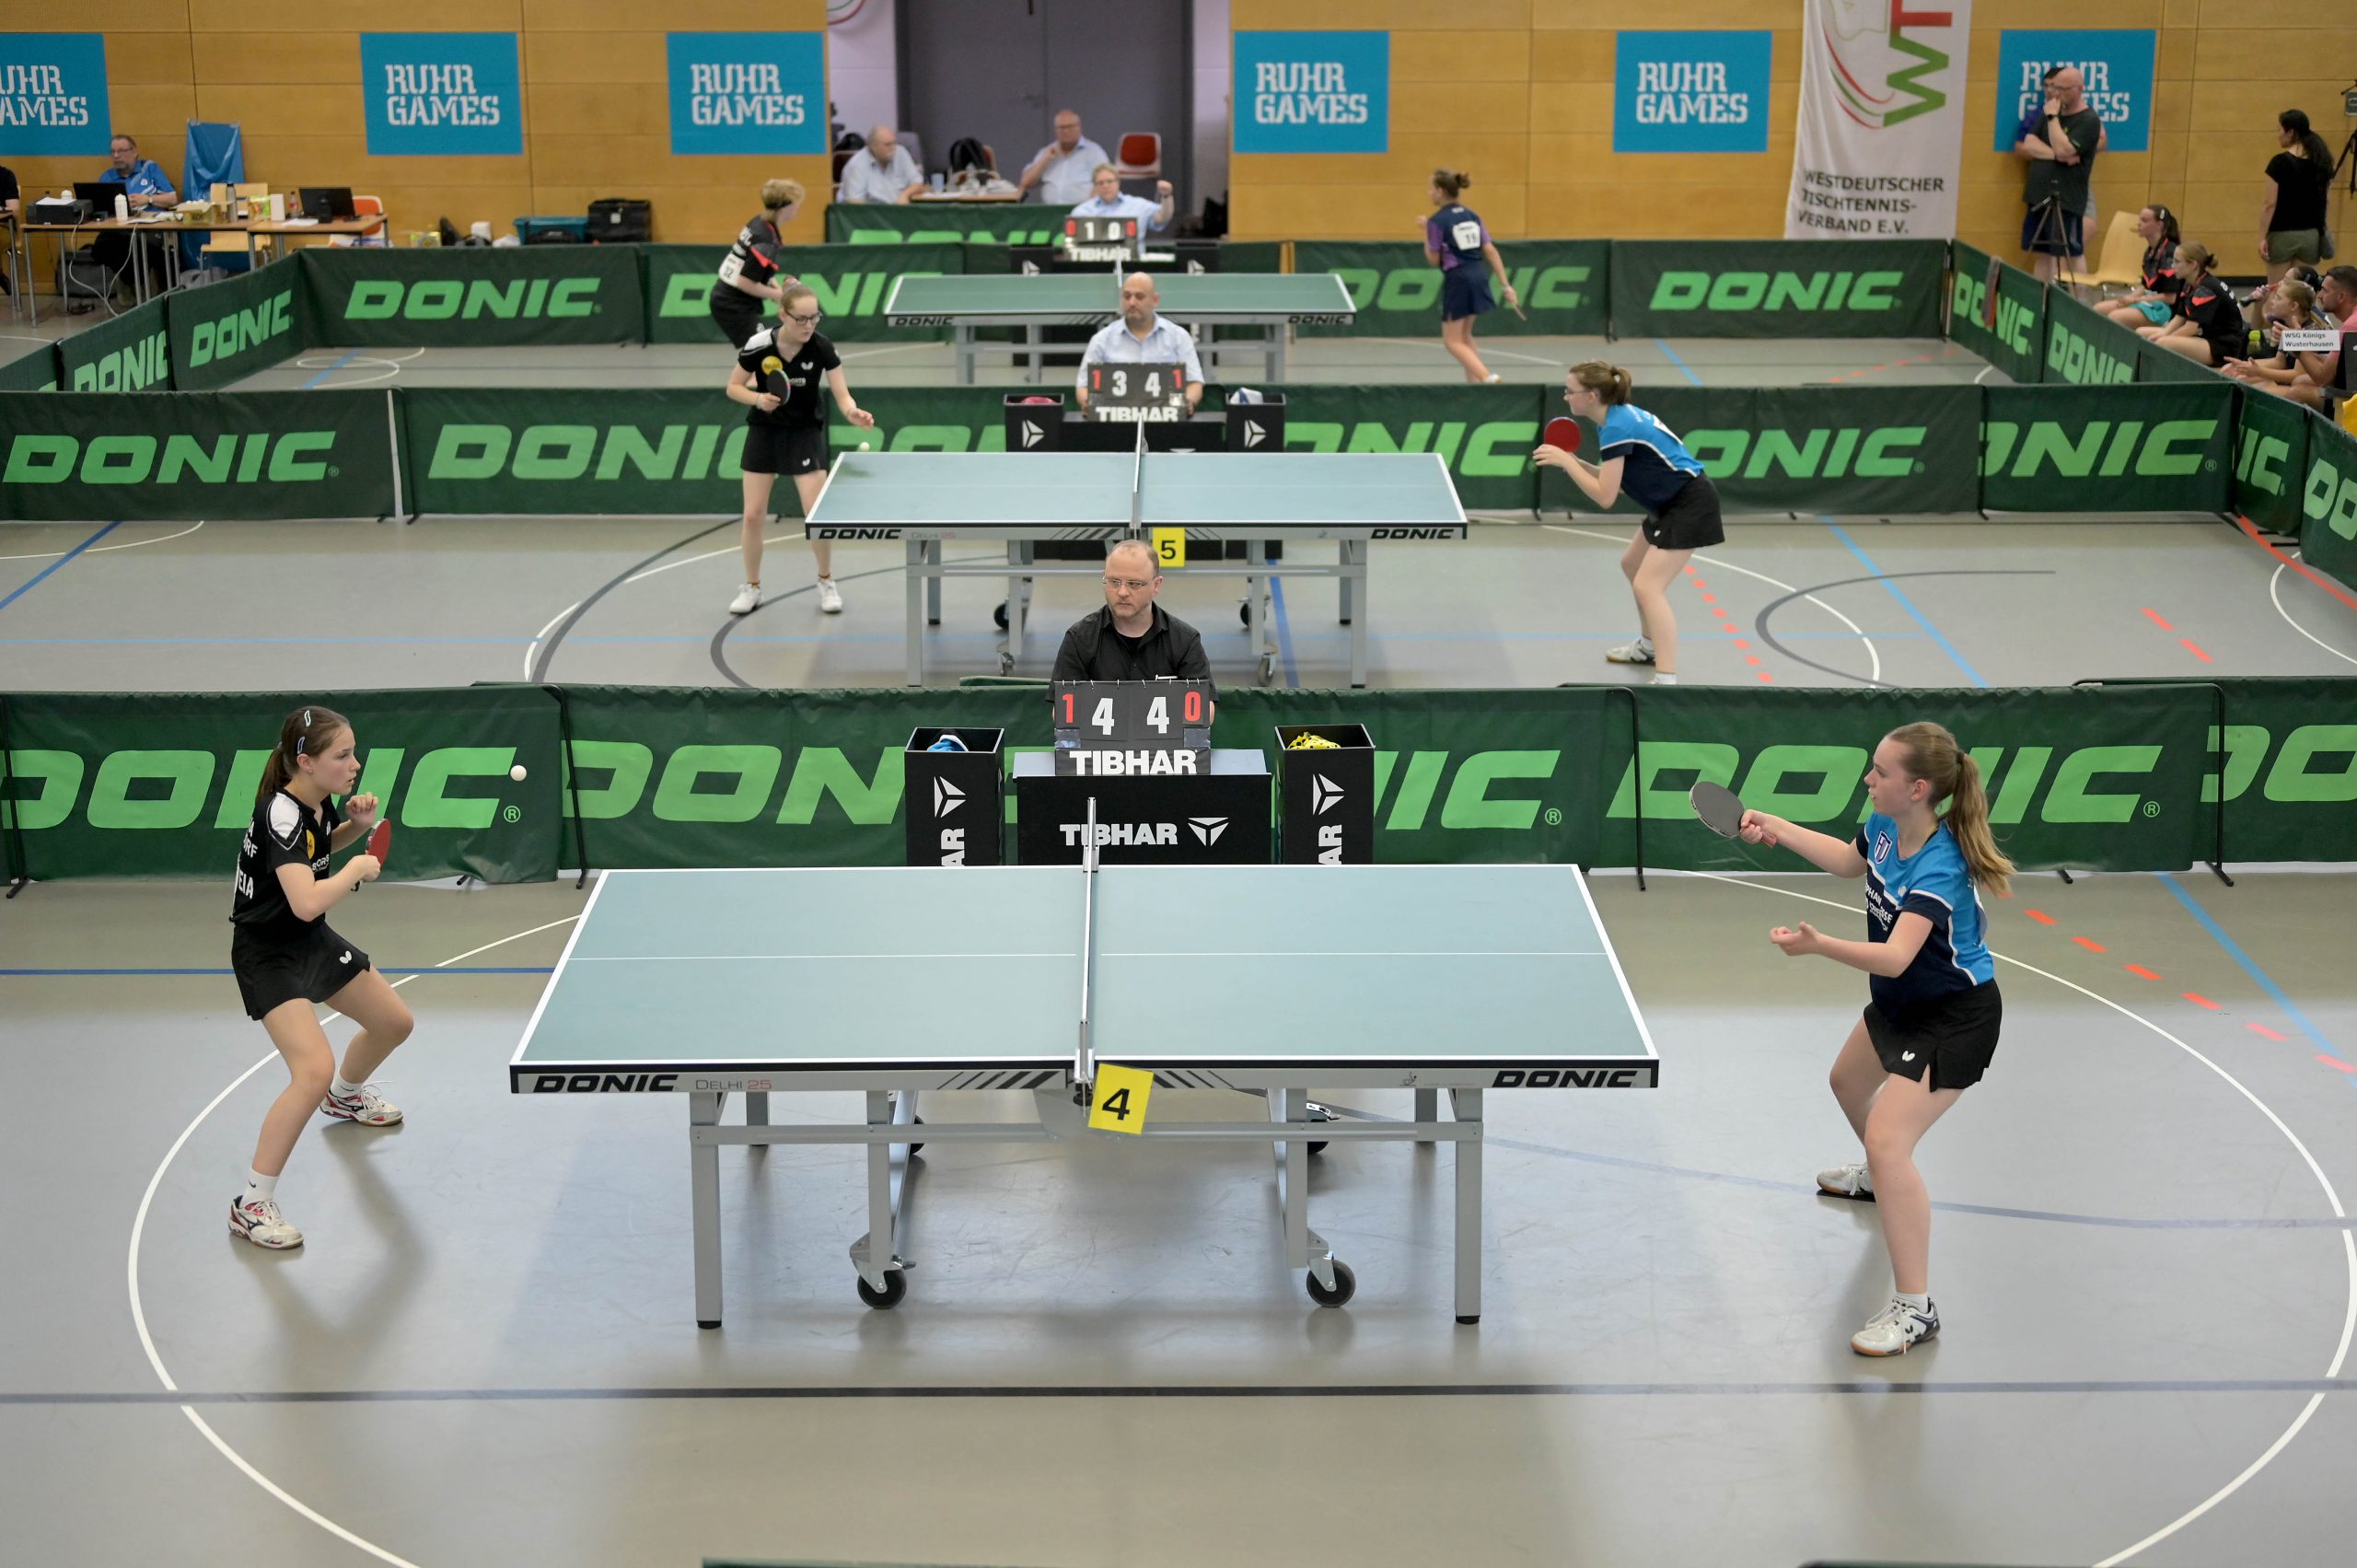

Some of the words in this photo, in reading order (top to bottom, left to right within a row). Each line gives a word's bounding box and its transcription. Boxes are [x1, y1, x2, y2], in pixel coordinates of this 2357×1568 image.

[0, 65, 64, 95] UHR
[385, 64, 477, 94] RUHR
[691, 64, 782, 93] RUHR
[1256, 63, 1346, 92] RUHR
[1637, 62, 1727, 92] RUHR
[0, 96, 88, 125] AMES
[387, 96, 501, 125] GAMES
[691, 95, 805, 125] GAMES
[1255, 94, 1368, 124] GAMES
[1636, 93, 1748, 123] GAMES
[1805, 169, 1945, 192] WESTDEUTSCHER
[1085, 221, 1095, 240] 1
[1108, 221, 1120, 240] 0
[1798, 210, 1871, 233] VERBAND
[1876, 220, 1910, 234] E.V.
[1069, 248, 1132, 261] TIBHAR
[344, 277, 601, 319] DONIC
[1649, 271, 1903, 311] DONIC
[190, 290, 292, 367] DONIC
[894, 316, 953, 326] DONIC
[1288, 315, 1347, 325] DONIC
[1092, 369, 1101, 391] 1
[1112, 370, 1127, 397] 3
[1144, 372, 1161, 398] 4
[1172, 368, 1182, 389] 1
[1095, 406, 1178, 423] TIBHAR
[3, 431, 336, 484] DONIC
[819, 528, 901, 540] DONIC
[1370, 528, 1455, 540] DONIC
[1161, 540, 1176, 560] 5
[1062, 693, 1074, 723] 1
[1092, 697, 1115, 735] 4
[1146, 696, 1169, 734] 4
[1184, 691, 1202, 722] 0
[1069, 749, 1197, 775] TIBHAR
[1059, 822, 1178, 846] TIBHAR
[533, 1074, 679, 1093] DONIC
[696, 1080, 742, 1090] DELHI
[747, 1080, 772, 1090] 25
[1491, 1070, 1638, 1088] DONIC
[1101, 1087, 1132, 1121] 4
